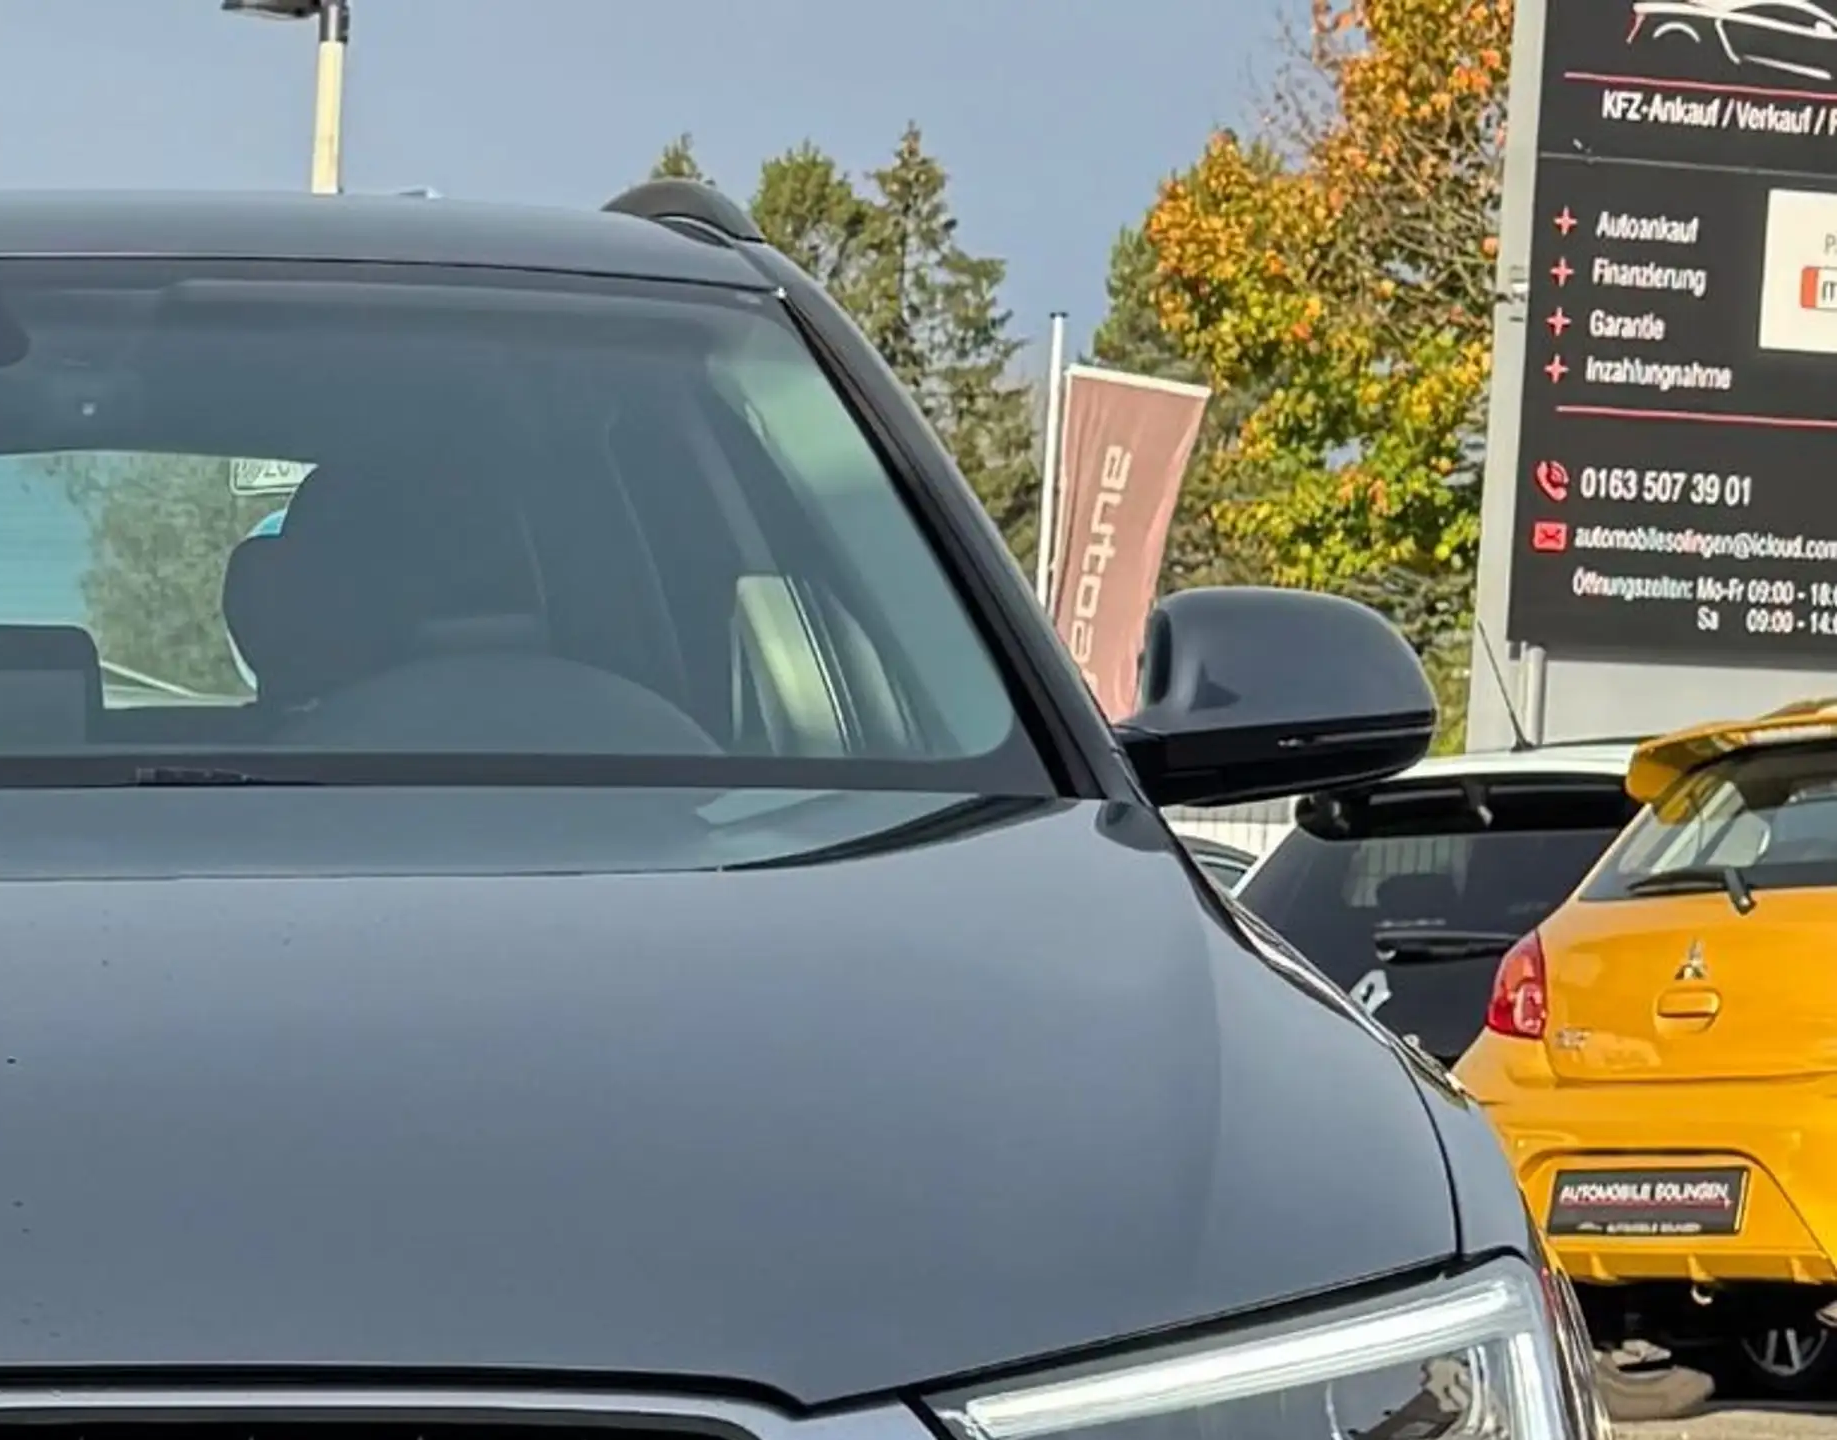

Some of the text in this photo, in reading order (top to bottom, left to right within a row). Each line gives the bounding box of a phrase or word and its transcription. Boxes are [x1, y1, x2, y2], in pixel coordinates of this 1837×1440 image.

[1736, 101, 1813, 134] Verkauf
[1595, 211, 1700, 244] Autoankauf
[1592, 257, 1707, 297] Finanzierung
[1589, 309, 1666, 340] Garantie
[1585, 355, 1732, 391] Inzahlungnahme
[1580, 467, 1752, 507] 0163 507 39 01
[1696, 577, 1745, 601] Mo-Fr
[1747, 579, 1795, 604] 09:00
[1696, 605, 1720, 630] Sa
[1746, 608, 1794, 633] 09:00
